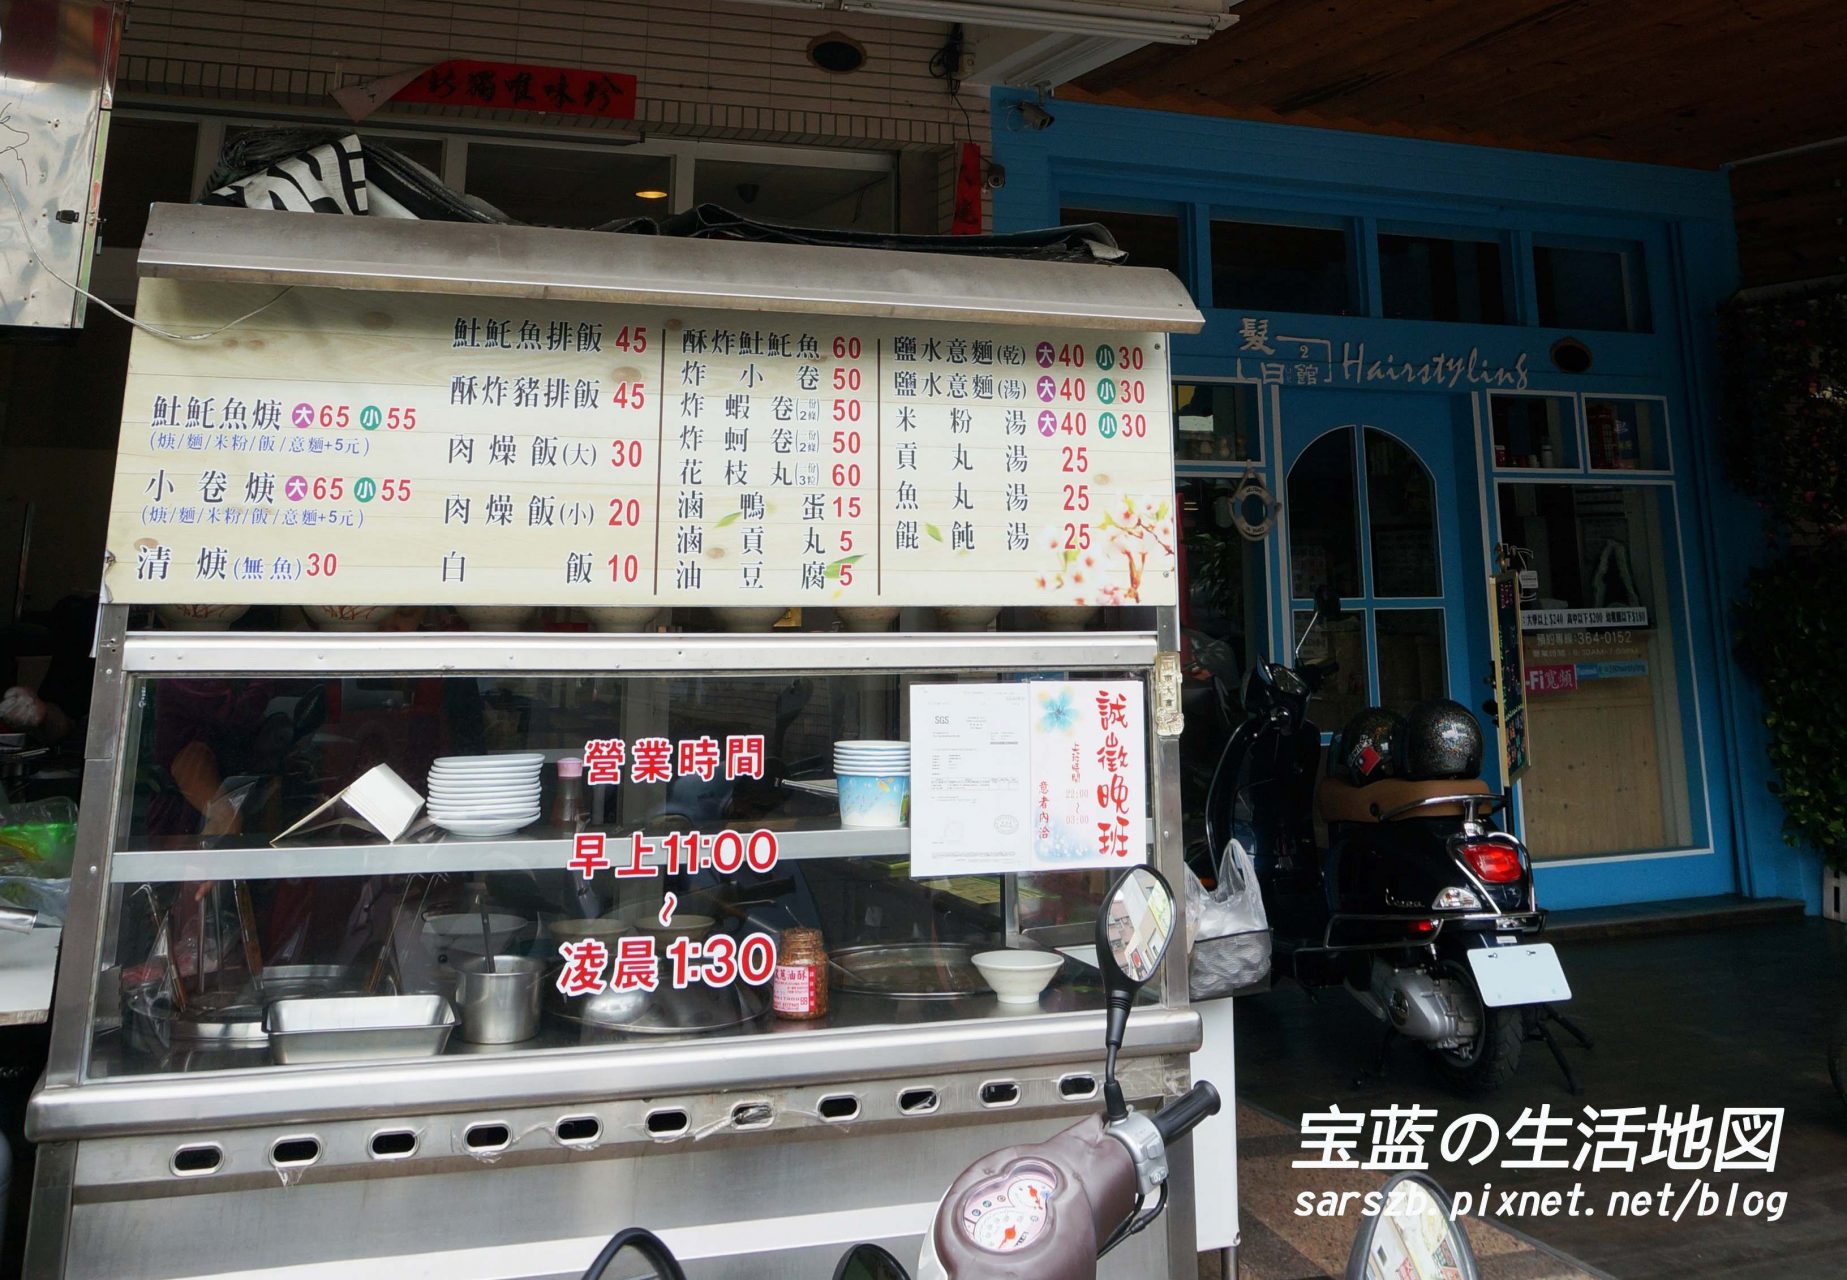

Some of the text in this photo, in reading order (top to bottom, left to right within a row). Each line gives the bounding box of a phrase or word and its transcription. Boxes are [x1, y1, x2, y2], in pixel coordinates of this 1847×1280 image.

[615, 326, 647, 353] 45
[832, 337, 861, 359] 60
[1059, 344, 1084, 368] 40
[1119, 346, 1143, 370] 30
[1343, 341, 1530, 390] Hairstyling
[450, 375, 645, 409] 酥炸豬排飯 45
[832, 368, 861, 390] 50
[1060, 377, 1086, 401] 40
[1120, 380, 1145, 403] 30
[319, 405, 350, 428] 65
[386, 407, 416, 430] 55
[832, 399, 861, 422] 50
[1061, 412, 1087, 436] 40
[1122, 413, 1146, 438] 30
[611, 440, 642, 467] 30
[832, 431, 861, 454] 50
[1062, 446, 1088, 472] 25
[832, 464, 861, 486] 60
[313, 477, 344, 500] 65
[381, 479, 411, 502] 55
[1063, 484, 1089, 511] 25
[608, 499, 640, 526] 20
[832, 497, 861, 518] 15
[840, 531, 852, 552] 5
[1064, 523, 1091, 550] 25
[307, 552, 337, 576] 30
[608, 555, 638, 582] 10
[840, 565, 852, 586] 5
[934, 715, 950, 725] SGS
[585, 736, 764, 784] 營業時間
[1096, 690, 1129, 857] 誠徵晚班
